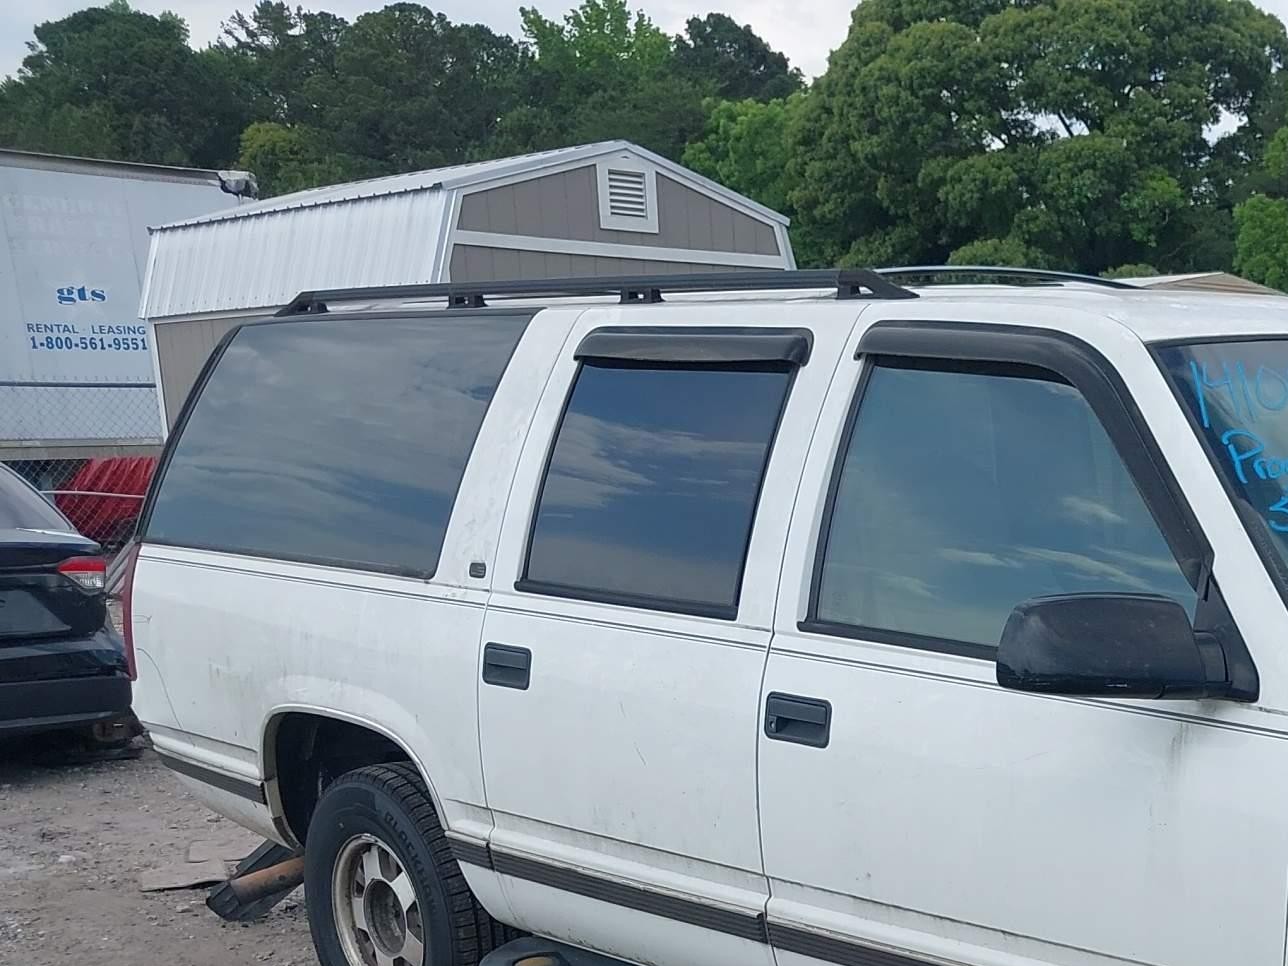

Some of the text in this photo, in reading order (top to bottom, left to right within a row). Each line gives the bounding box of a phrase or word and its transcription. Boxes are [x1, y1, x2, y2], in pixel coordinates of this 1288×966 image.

[56, 286, 106, 305] gts
[27, 323, 146, 335] RENTAL LEASING
[31, 336, 148, 351] 1-800-561-9551
